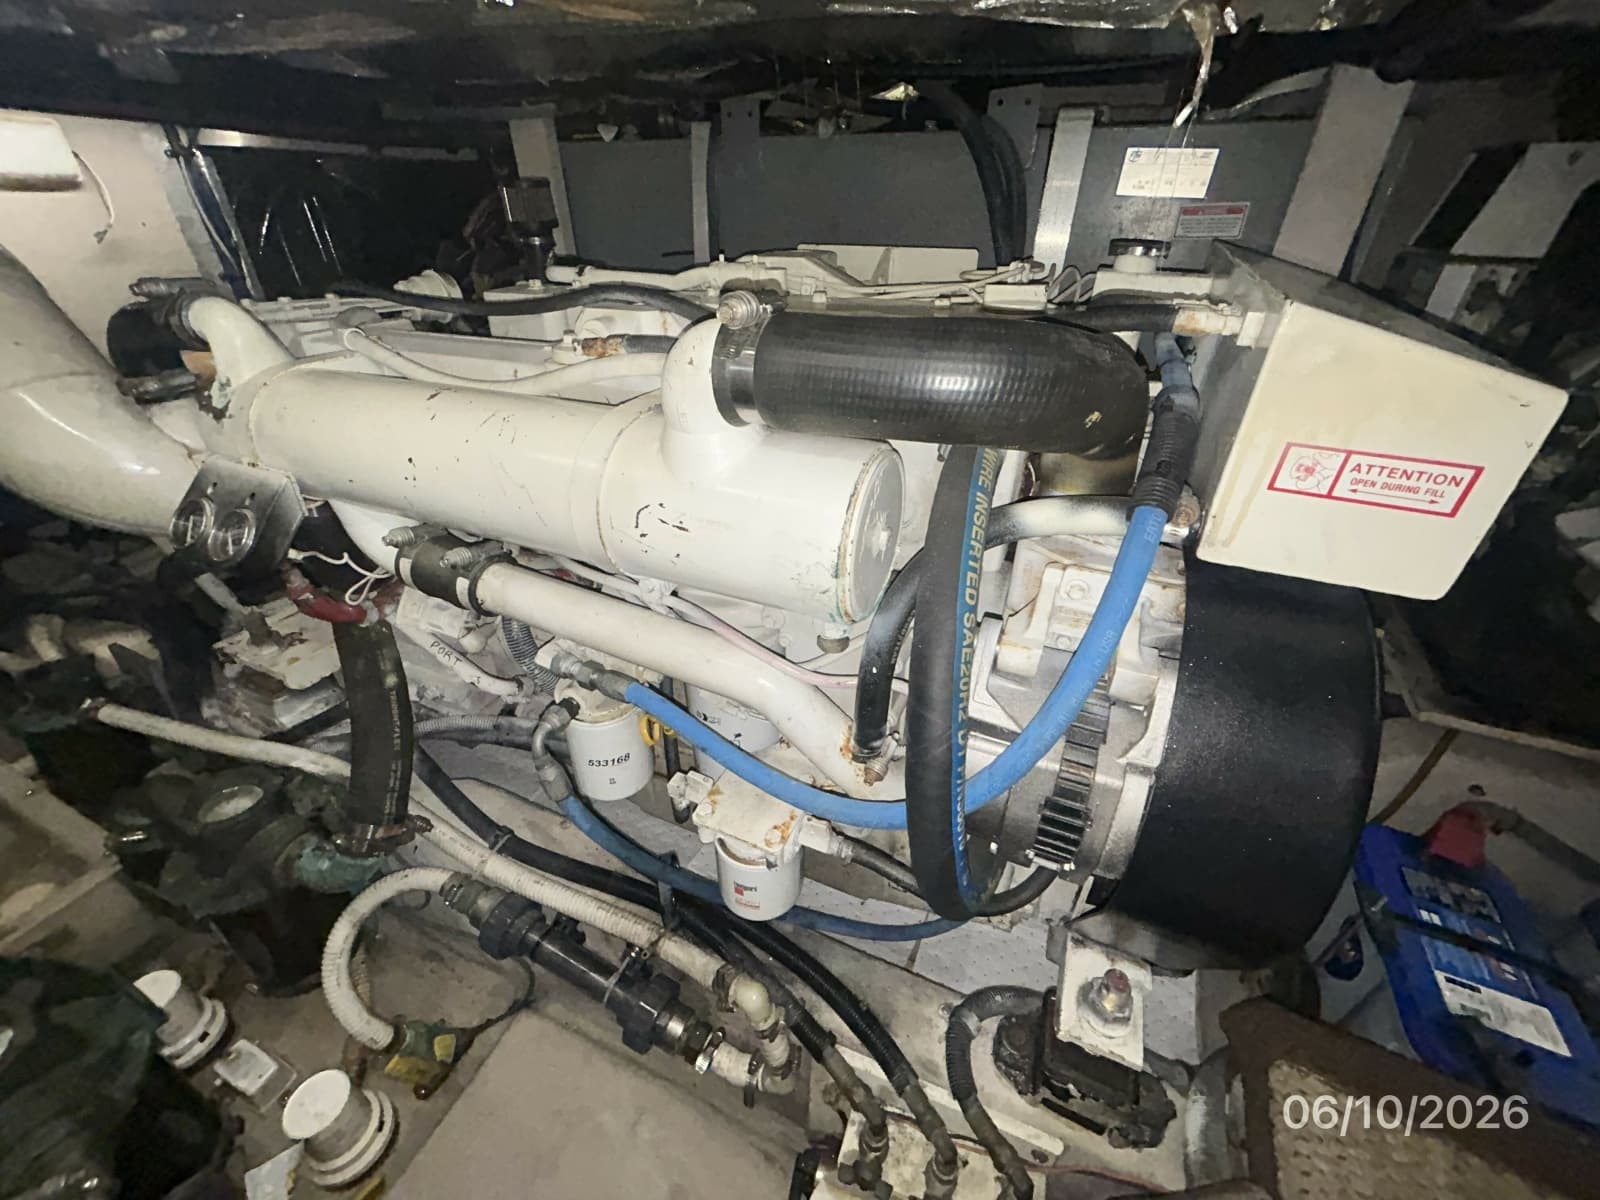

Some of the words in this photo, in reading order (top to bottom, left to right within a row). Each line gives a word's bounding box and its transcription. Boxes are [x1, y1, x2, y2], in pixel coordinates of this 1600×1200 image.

[978, 448, 998, 492] WIRE
[1350, 462, 1464, 488] ATTENTION
[1350, 477, 1377, 488] OPEN
[1380, 481, 1421, 495] DURING
[1424, 487, 1446, 498] FILL
[964, 492, 991, 606] INSERTED
[430, 640, 463, 666] PORT
[588, 752, 630, 767] 533168
